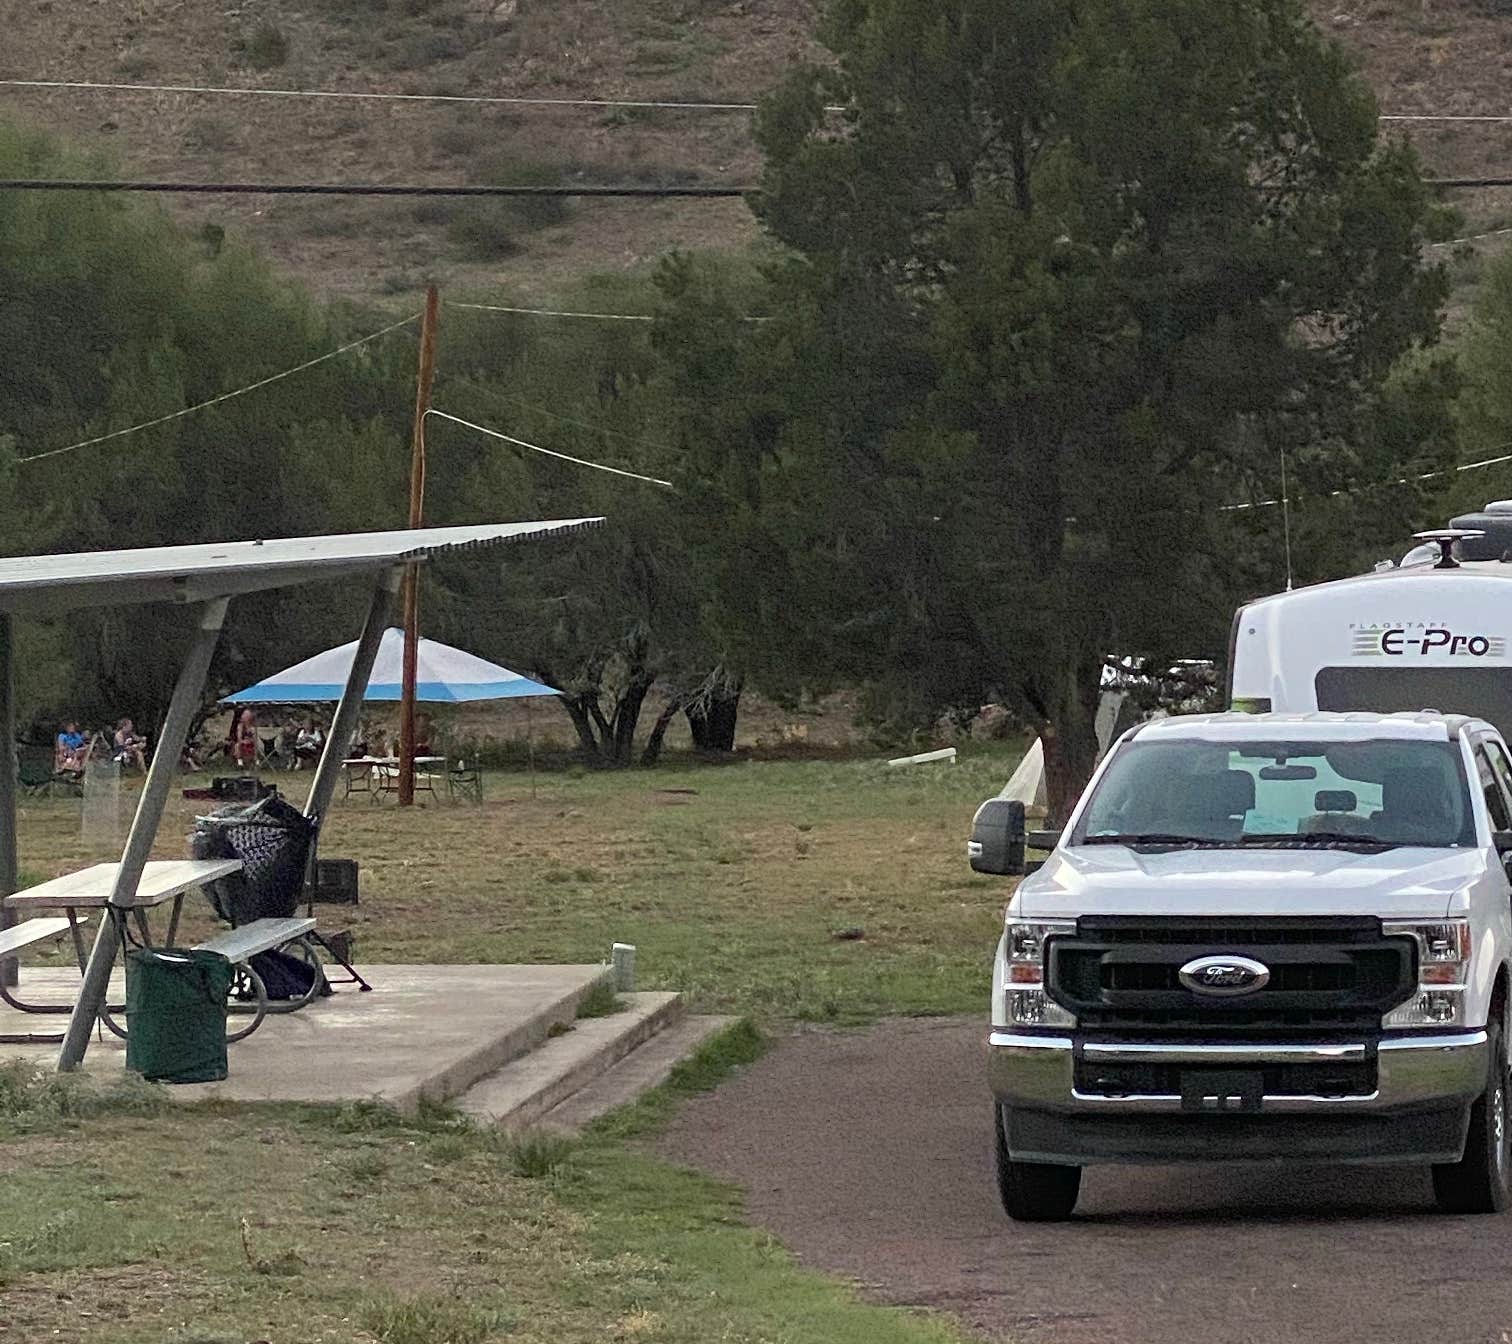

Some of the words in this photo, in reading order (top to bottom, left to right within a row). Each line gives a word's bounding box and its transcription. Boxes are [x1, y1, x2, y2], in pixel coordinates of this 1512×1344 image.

[1348, 621, 1449, 629] FLAGSTAFF
[1381, 629, 1490, 656] E-Pro
[1203, 966, 1246, 985] Ford
